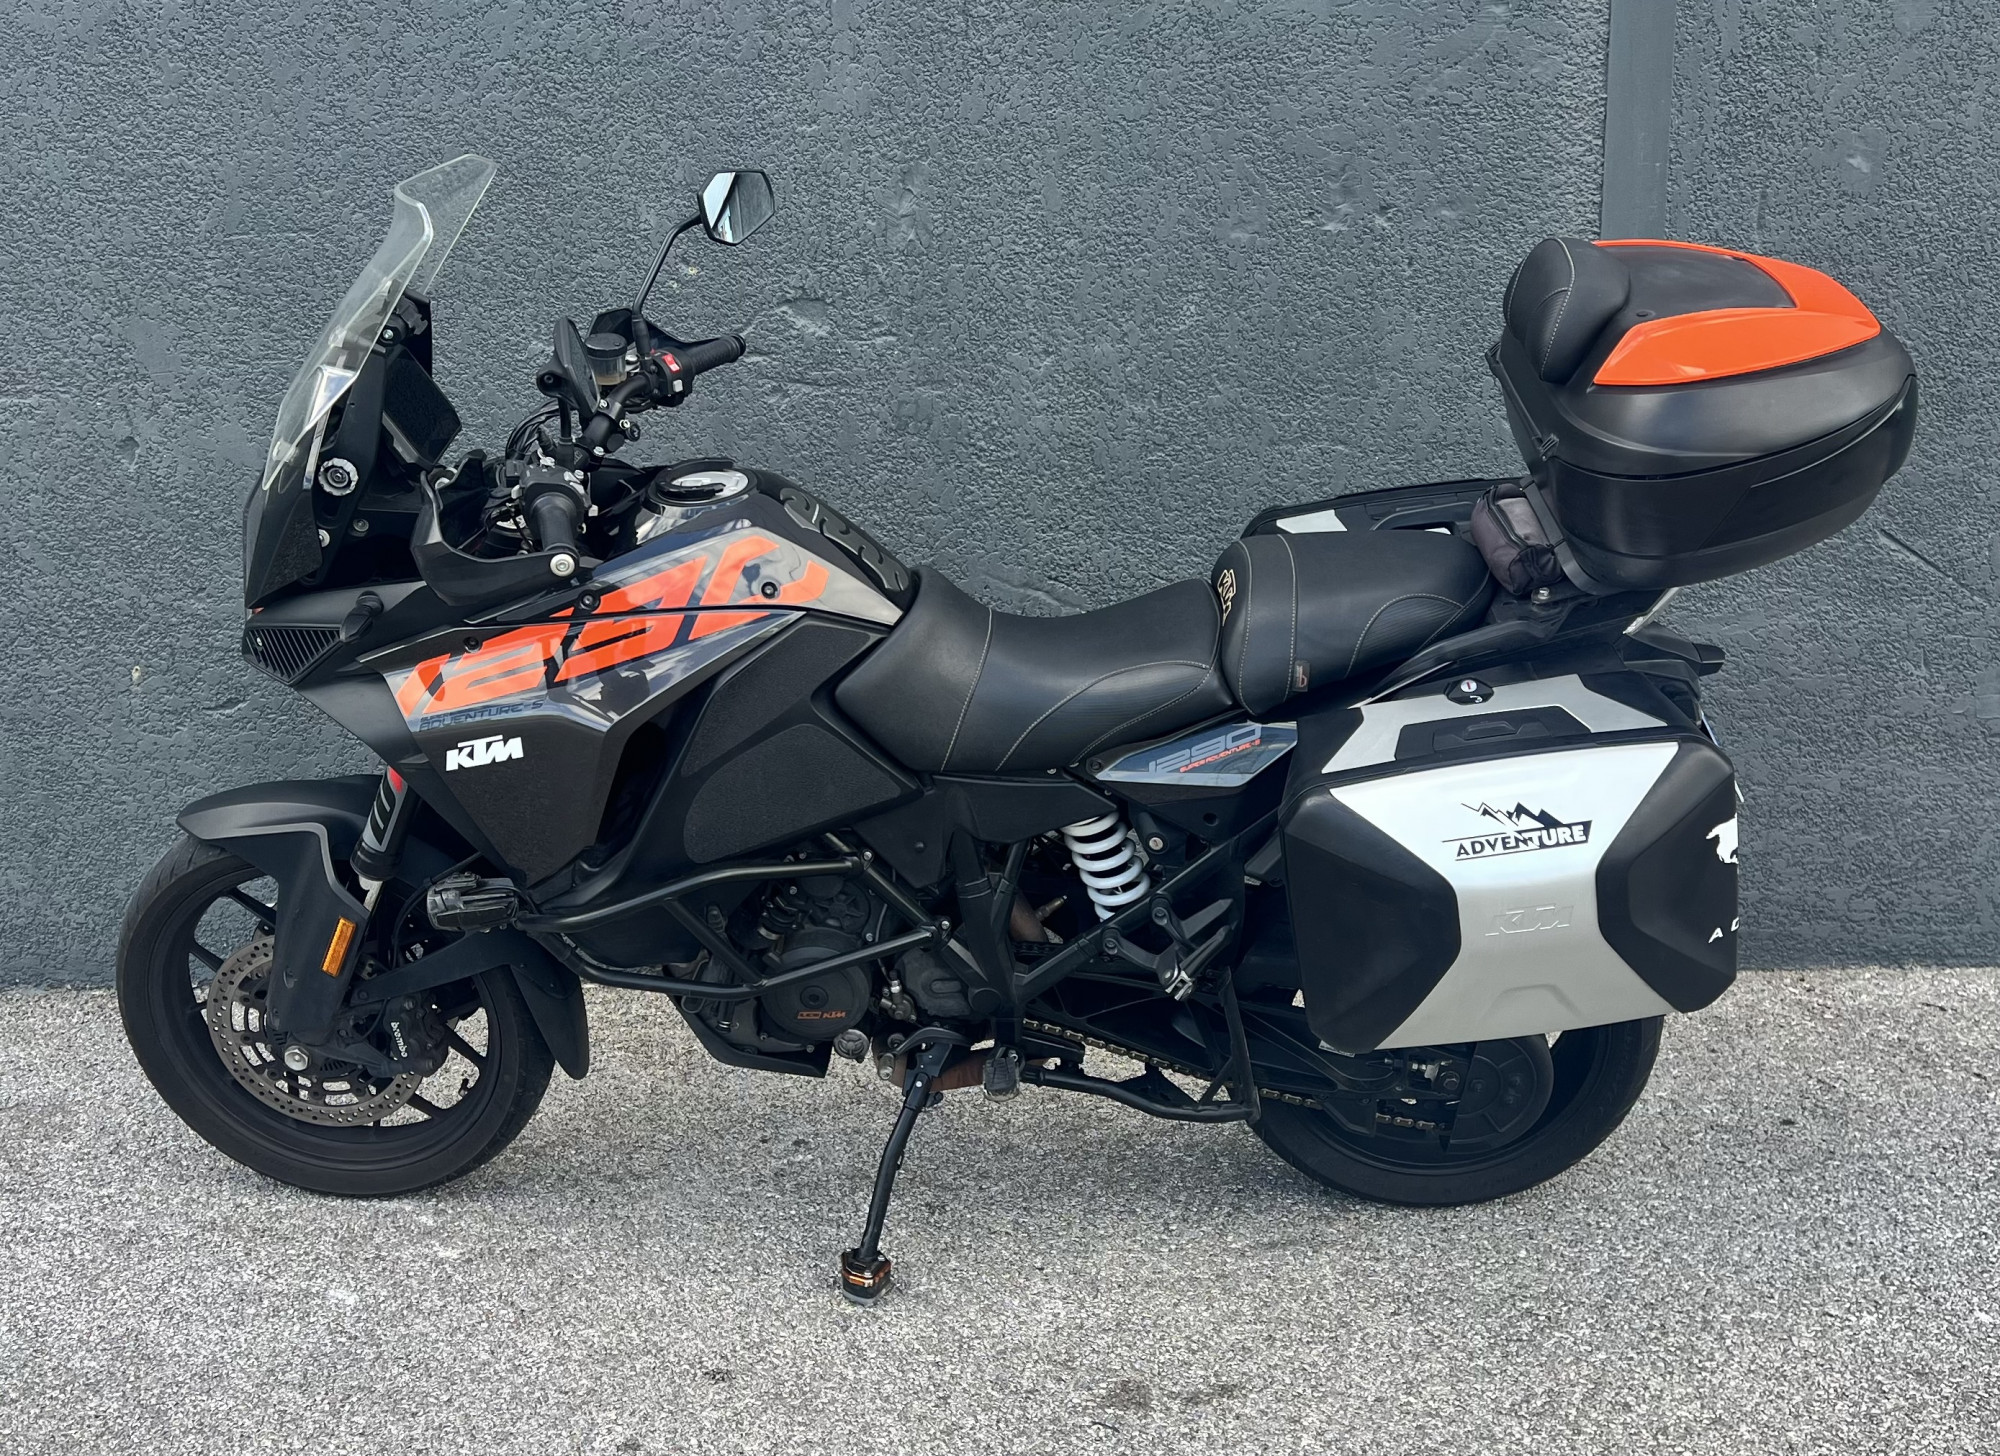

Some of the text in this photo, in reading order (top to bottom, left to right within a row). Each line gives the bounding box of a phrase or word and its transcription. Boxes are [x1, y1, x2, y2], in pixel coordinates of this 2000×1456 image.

[419, 700, 544, 732] ADVENTURE-S
[445, 735, 524, 772] KTM
[1148, 724, 1262, 775] 1290
[1456, 824, 1587, 858] ADVENTURE
[1482, 902, 1575, 937] KTM
[390, 1021, 408, 1058] brembo
